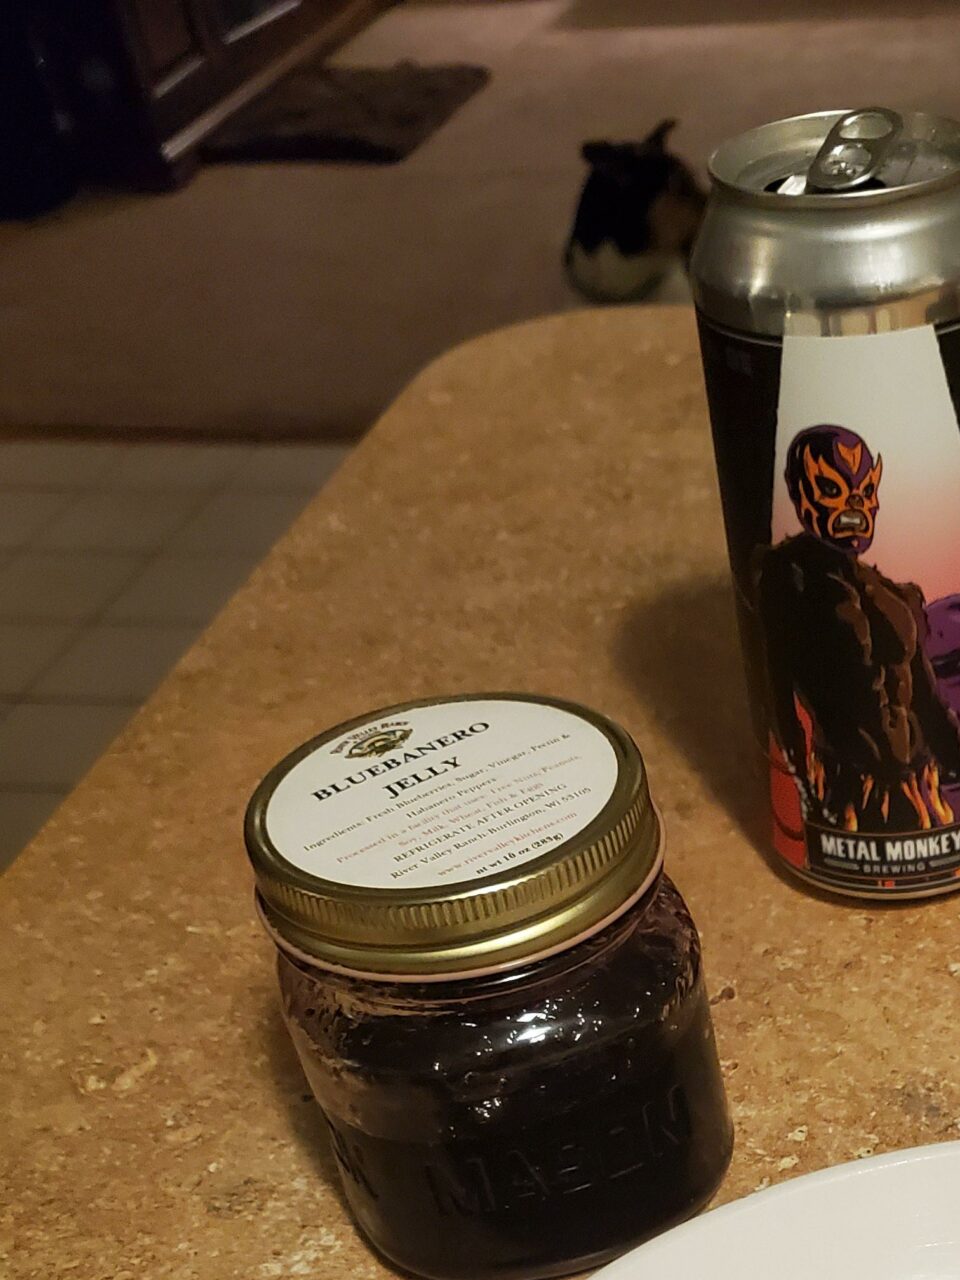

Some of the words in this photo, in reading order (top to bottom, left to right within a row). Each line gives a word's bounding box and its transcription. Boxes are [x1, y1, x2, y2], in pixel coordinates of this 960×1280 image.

[311, 722, 490, 802] BLUEBANERO
[382, 756, 461, 800] JELLY
[365, 807, 395, 823] Fresh
[406, 796, 456, 819] Habanero
[456, 777, 497, 797] Peppers
[393, 823, 473, 863] REFRIGERATE
[477, 805, 512, 826] AFTER
[513, 783, 568, 809] OPENING
[389, 863, 419, 880] River
[419, 848, 453, 865] Valley
[820, 833, 881, 862] METAL
[863, 862, 926, 875] BREWING
